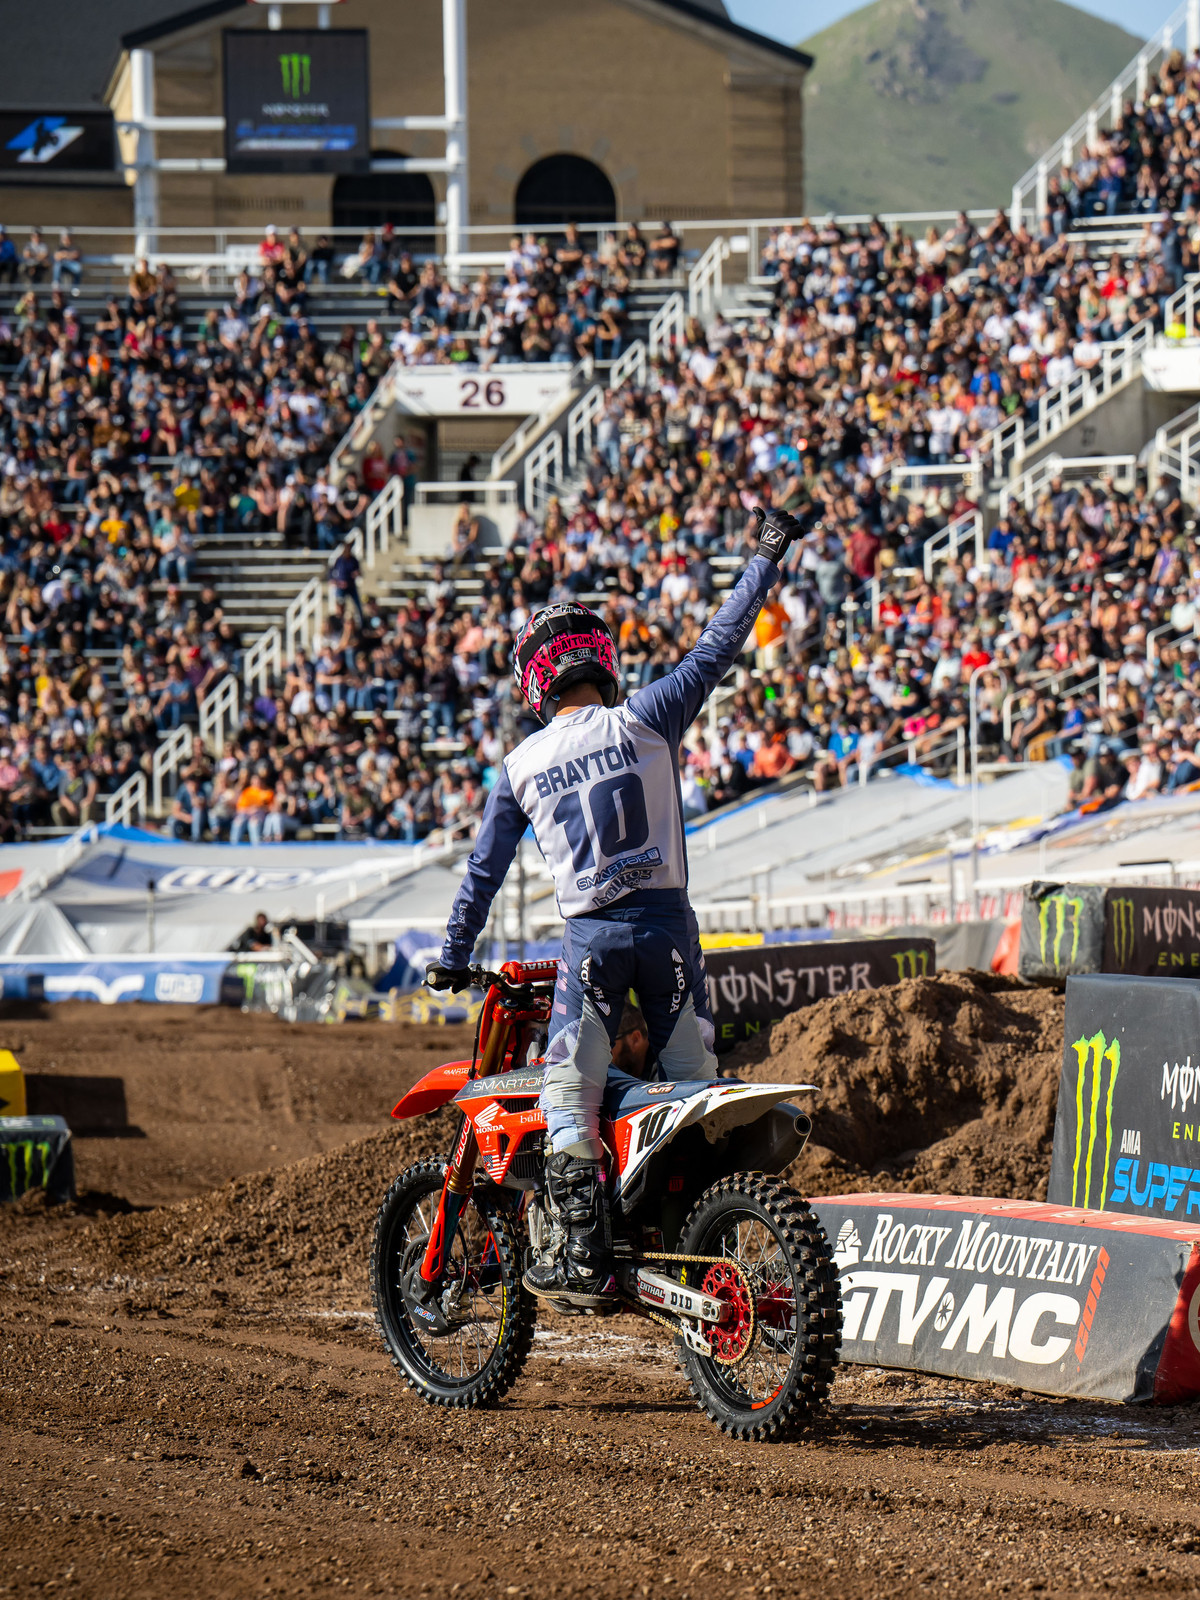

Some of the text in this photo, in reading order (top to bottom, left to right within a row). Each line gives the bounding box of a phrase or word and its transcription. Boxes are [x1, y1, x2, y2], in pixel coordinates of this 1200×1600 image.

[460, 380, 505, 408] 26
[550, 635, 595, 657] BRAYTONS
[729, 631, 741, 643] BE
[738, 615, 751, 633] THE
[534, 740, 639, 799] BRAYTON
[552, 772, 650, 873] 10
[669, 965, 686, 1014] HONDA
[475, 1124, 505, 1135] HONDA
[636, 1105, 674, 1155] 10
[1120, 1128, 1141, 1156] AMA
[862, 1213, 1098, 1286] ROCKY MOUNTAIN
